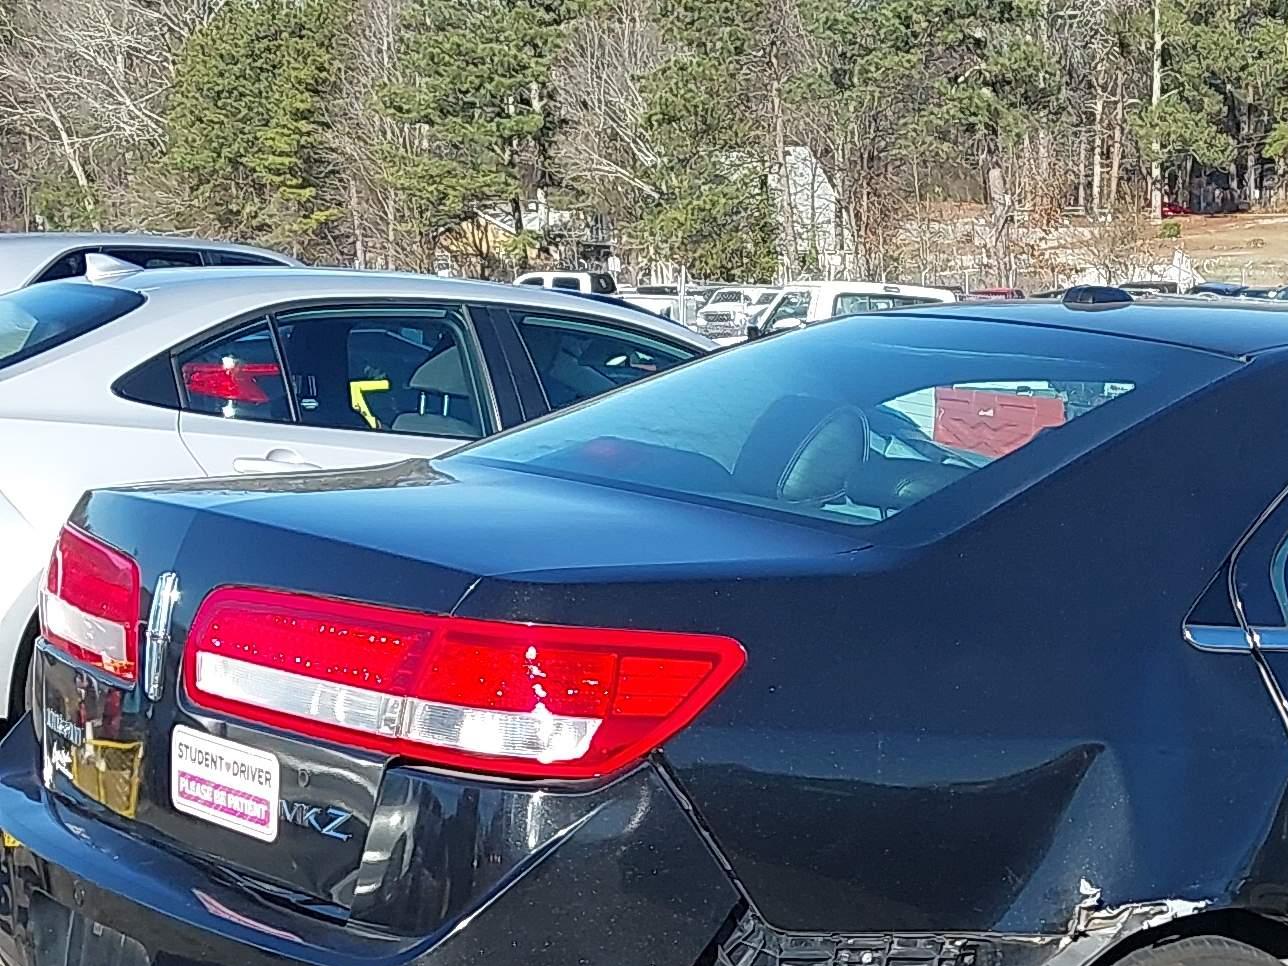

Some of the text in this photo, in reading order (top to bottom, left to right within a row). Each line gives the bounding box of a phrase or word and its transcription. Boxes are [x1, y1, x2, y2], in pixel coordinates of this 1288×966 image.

[178, 742, 272, 788] STUDENT DRIVER
[179, 777, 213, 803] PLEASE
[227, 792, 267, 819] PATIENT
[279, 799, 353, 842] MKZ
